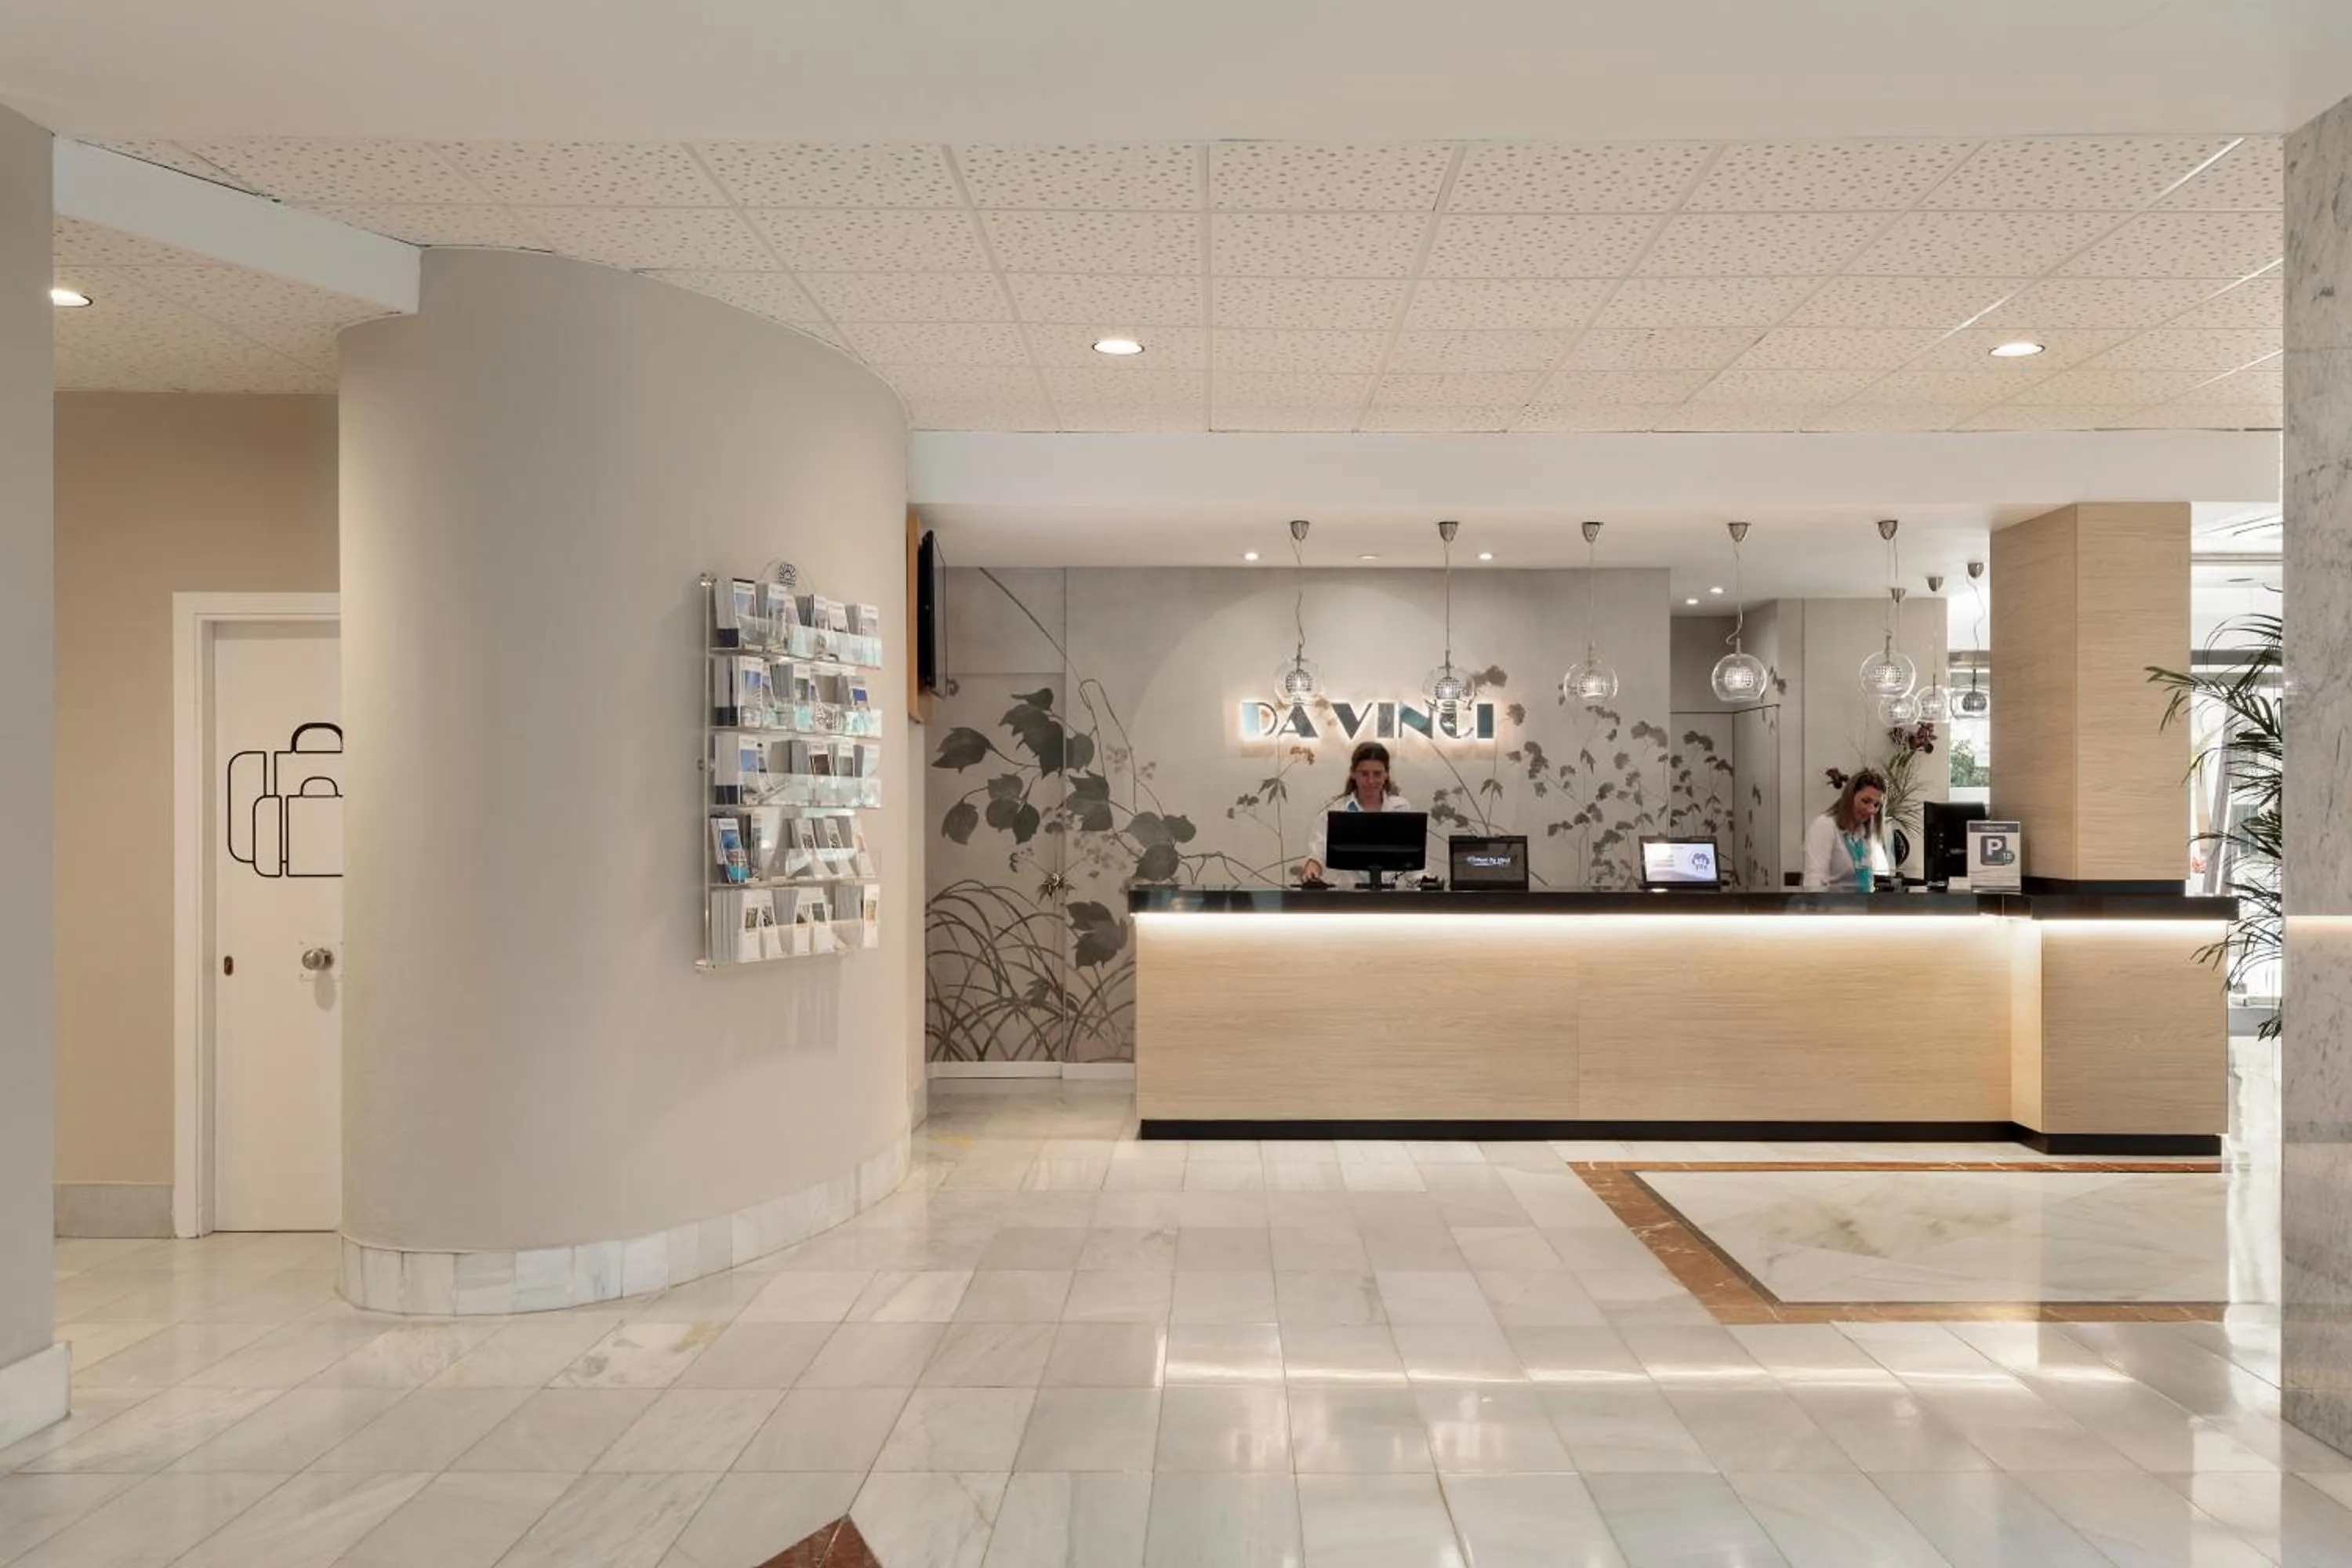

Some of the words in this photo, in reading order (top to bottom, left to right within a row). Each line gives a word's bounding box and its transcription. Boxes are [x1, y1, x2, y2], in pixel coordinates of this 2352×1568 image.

[1241, 702, 1319, 738] DA
[1330, 702, 1494, 739] VINCI
[1986, 838, 2003, 856] P
